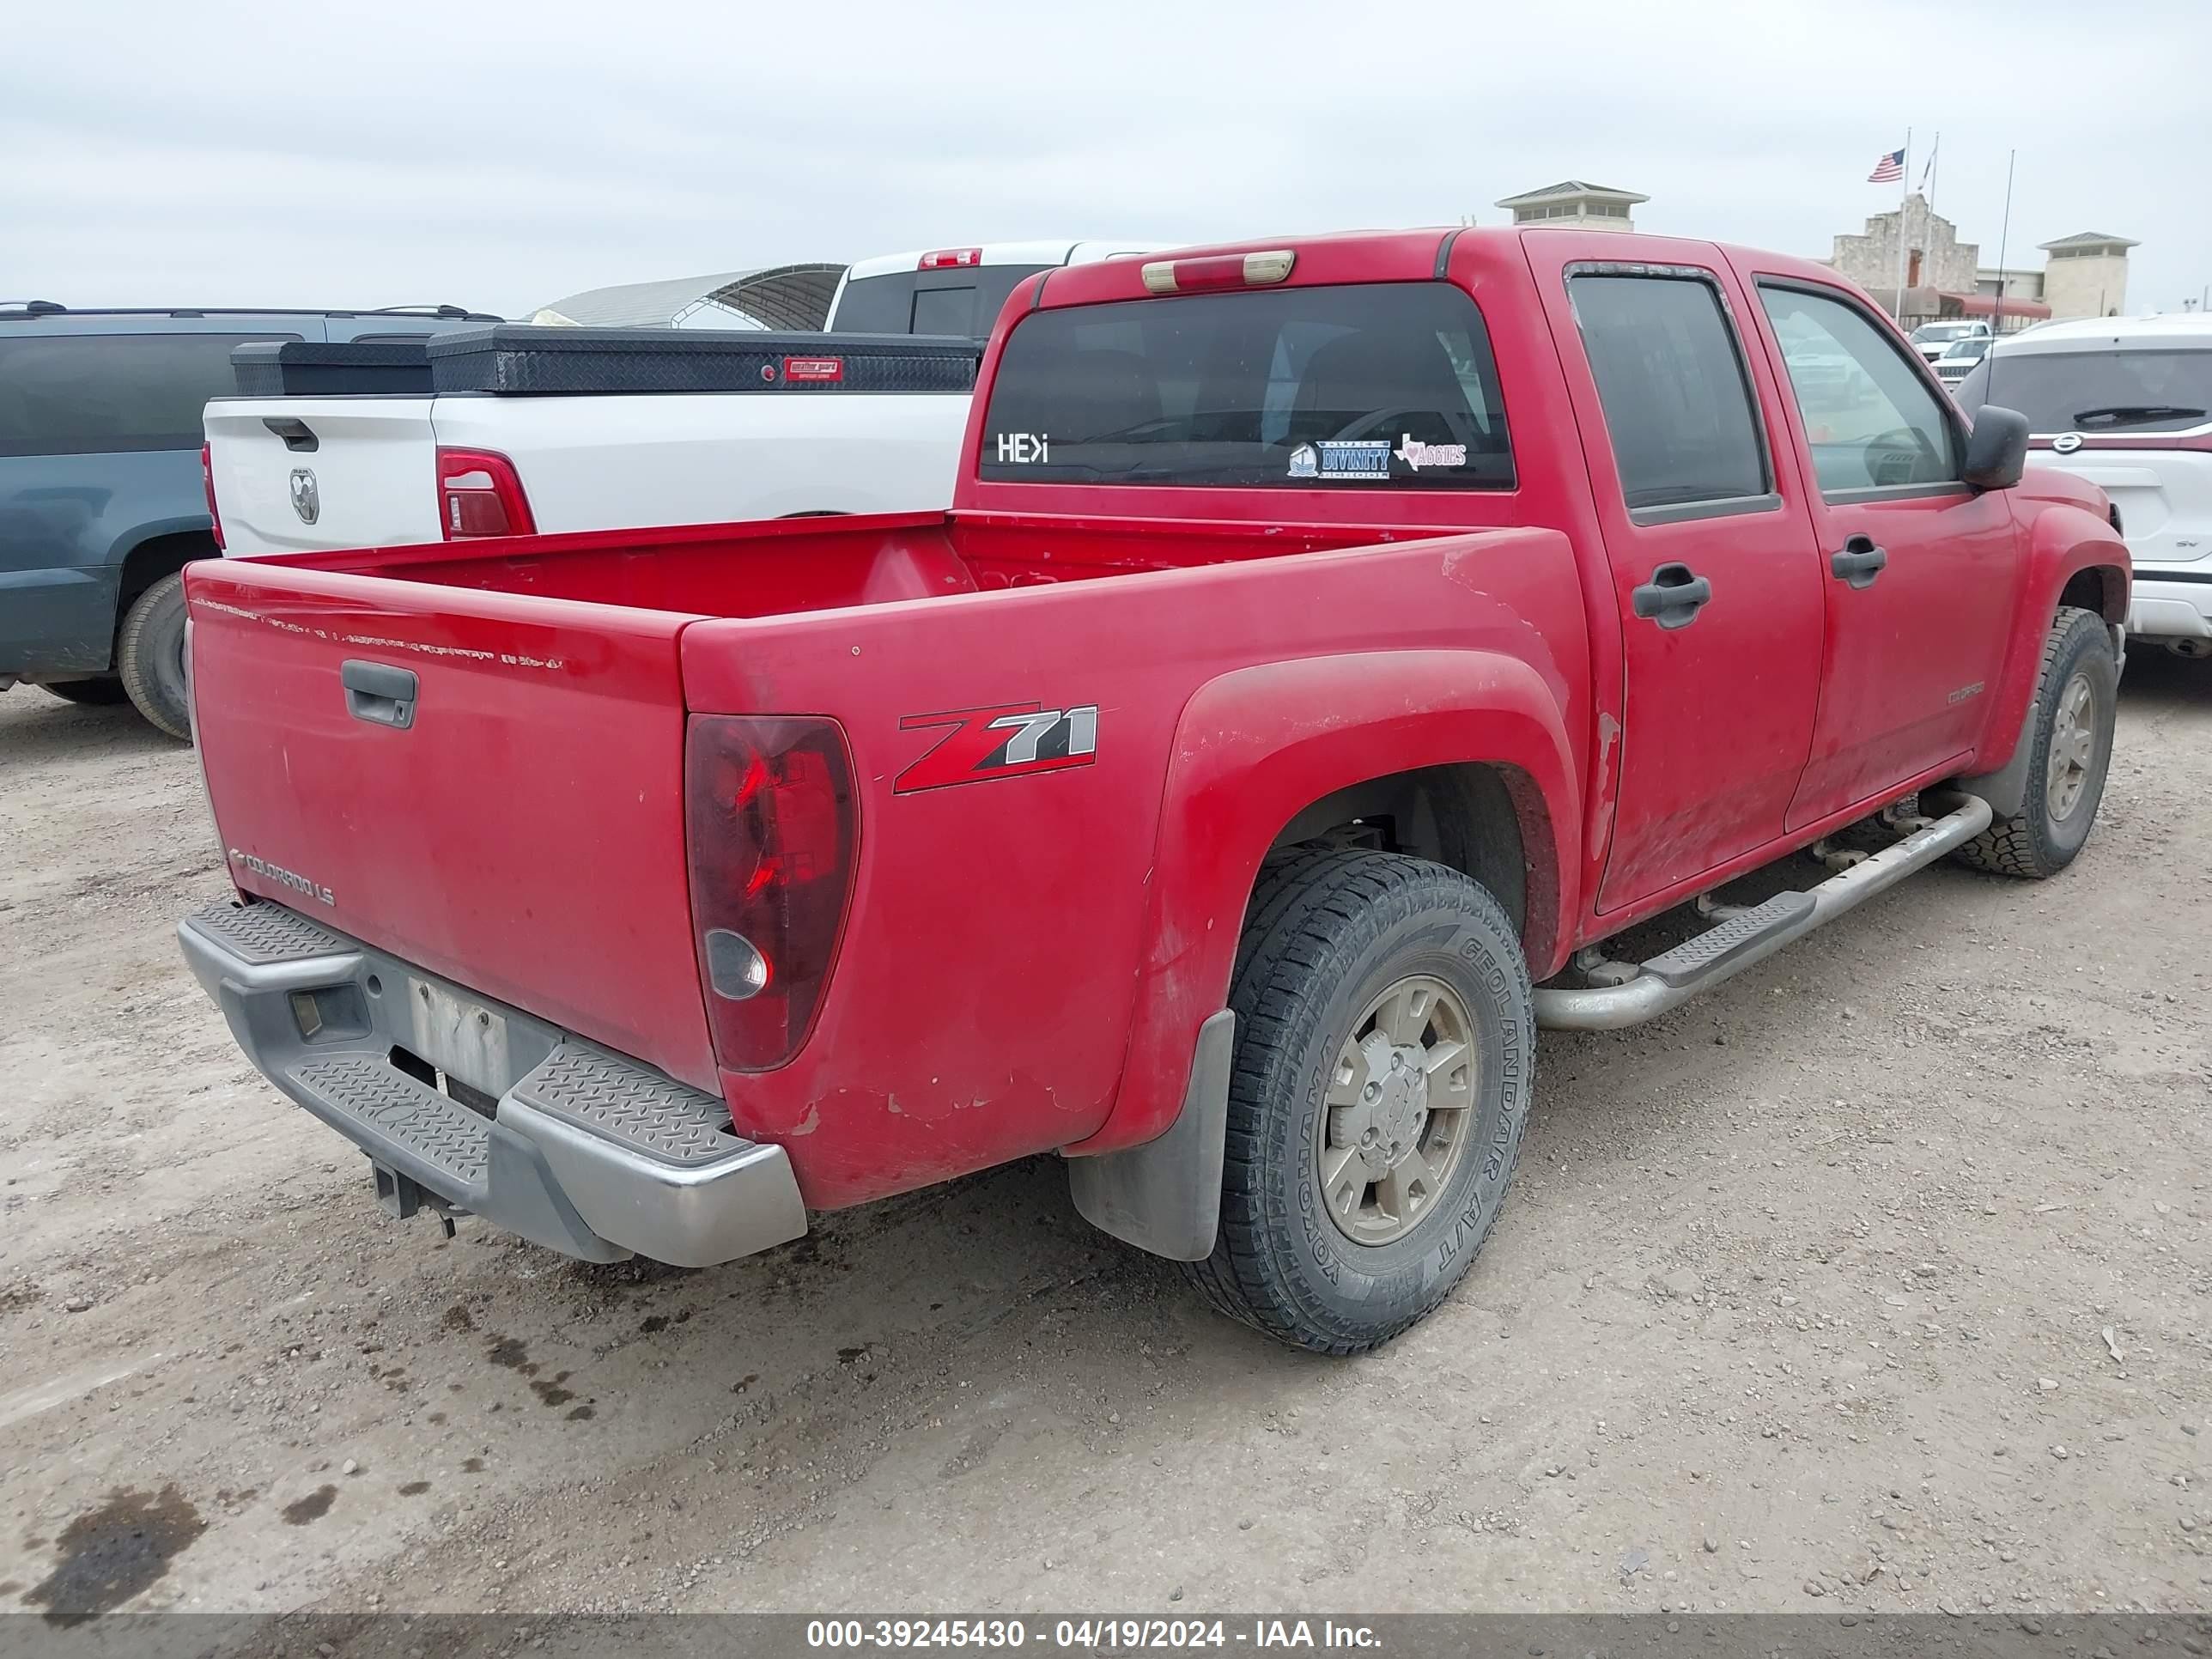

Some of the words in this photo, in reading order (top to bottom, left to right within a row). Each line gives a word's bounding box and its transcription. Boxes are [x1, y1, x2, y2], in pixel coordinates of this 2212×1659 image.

[1322, 448, 1390, 471] DIVINITY
[1416, 444, 1467, 466] AGGIES
[893, 701, 1098, 794] Z71
[246, 854, 315, 897] COLORADO
[315, 884, 336, 907] LS
[1459, 936, 1521, 1182] GEOLANDAR
[1297, 1033, 1341, 1286] YOKOHAMA
[1438, 1192, 1482, 1273] A/T
